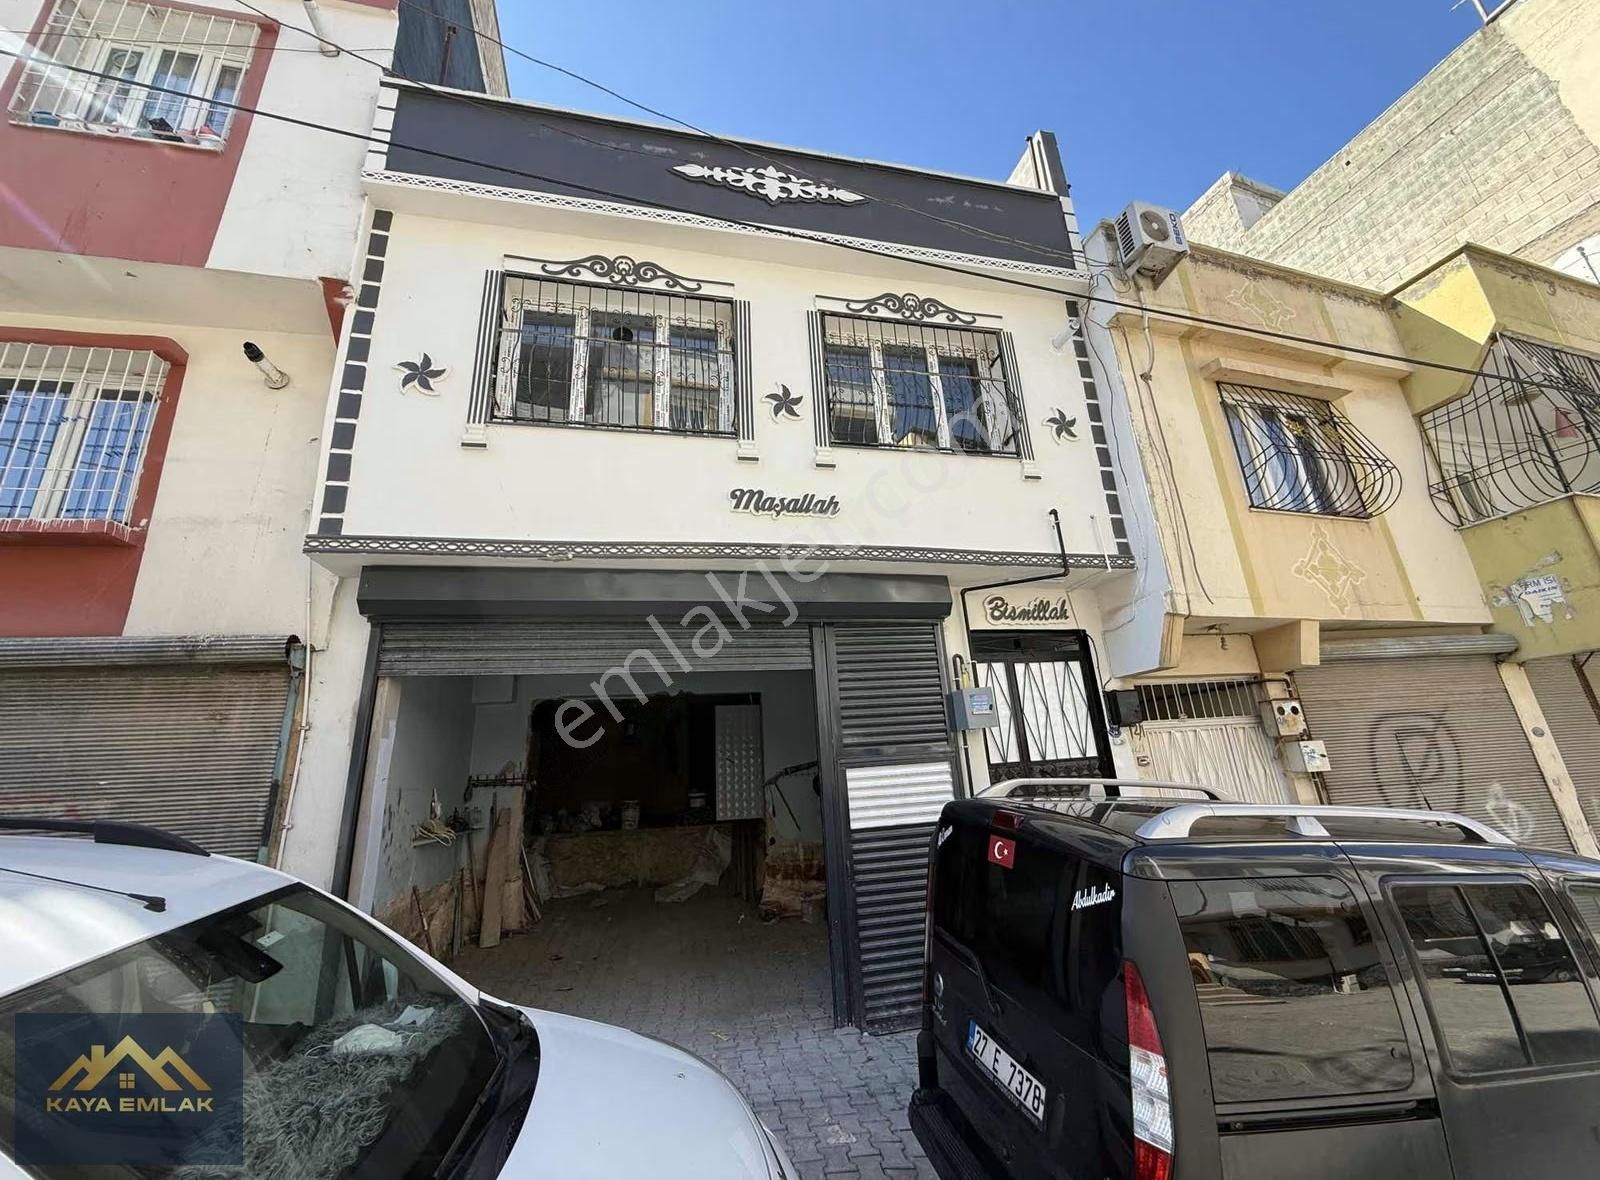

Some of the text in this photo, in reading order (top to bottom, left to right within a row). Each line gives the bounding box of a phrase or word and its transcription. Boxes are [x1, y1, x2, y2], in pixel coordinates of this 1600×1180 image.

[1168, 213, 1183, 245] BEKO
[729, 488, 841, 518] Maşallah
[986, 596, 1070, 621] Bismillah
[1071, 882, 1116, 911] Abdulkadir
[974, 1029, 988, 1058] 27
[992, 1046, 1002, 1075] E
[1008, 1061, 1042, 1114] 7378
